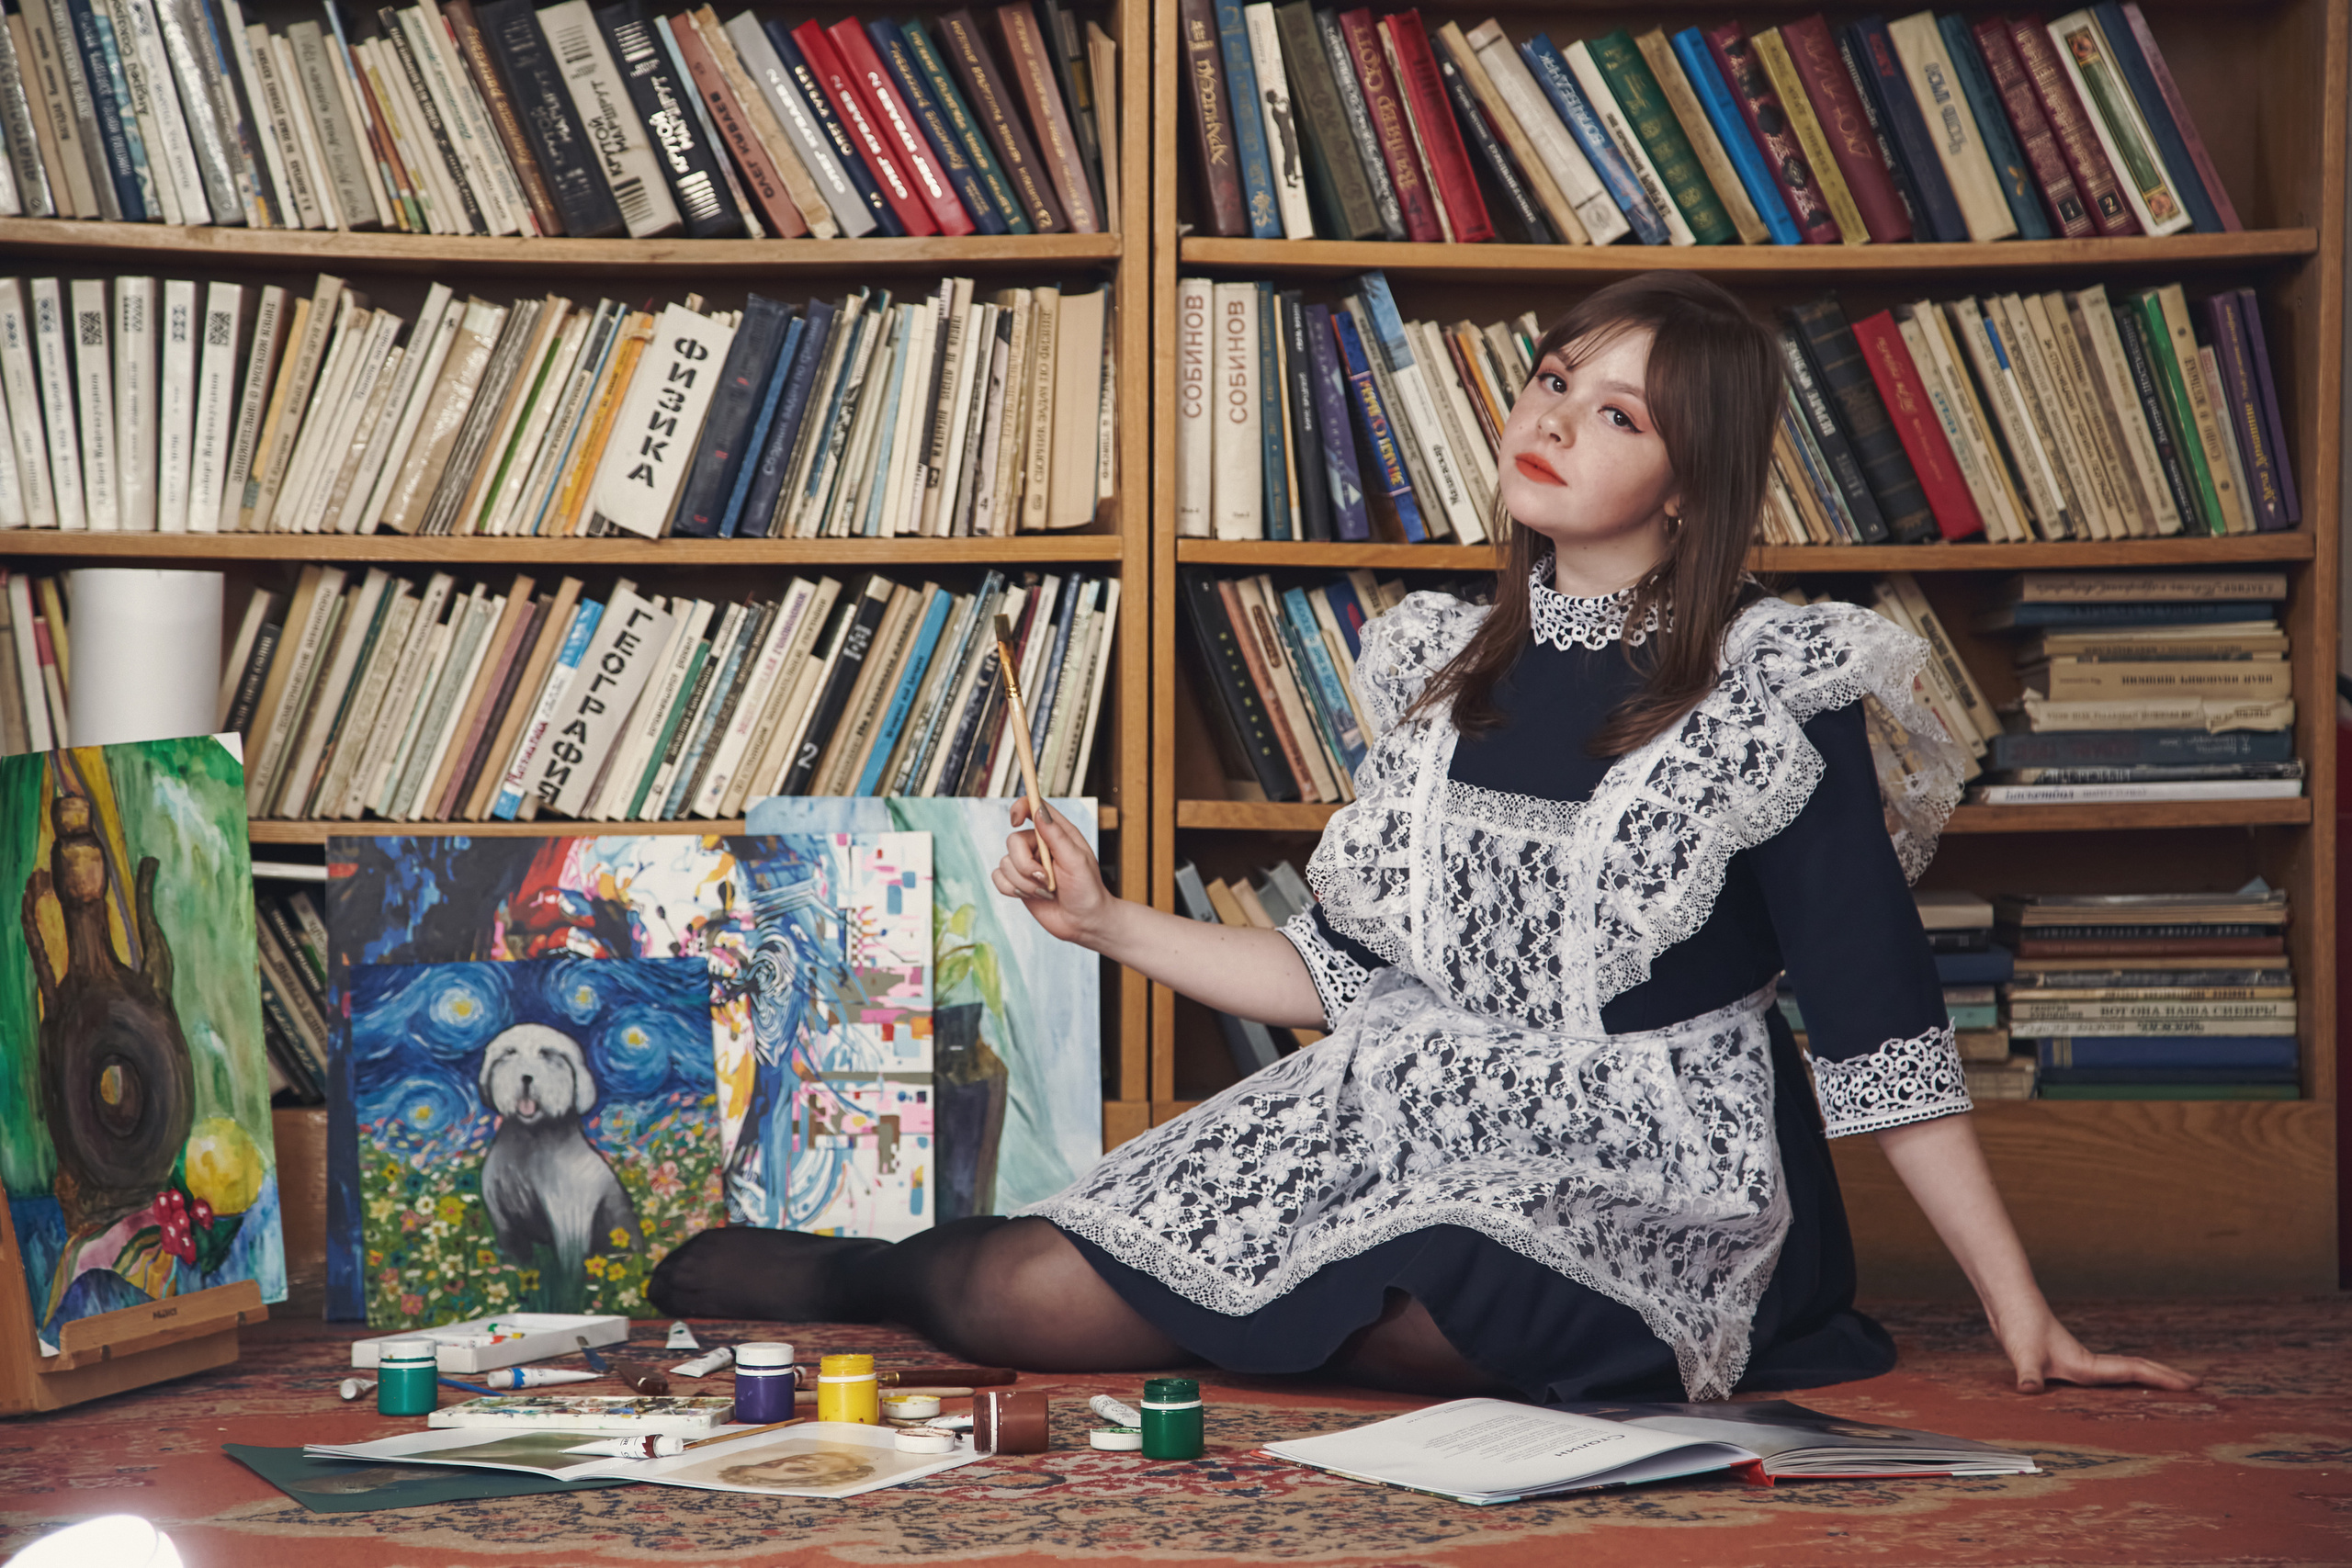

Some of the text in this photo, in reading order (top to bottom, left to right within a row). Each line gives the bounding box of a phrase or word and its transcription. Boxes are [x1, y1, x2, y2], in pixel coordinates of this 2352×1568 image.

[108, 0, 137, 57] Сахаро
[586, 115, 624, 177] КРУТОЙ
[589, 77, 629, 153] МАРШРУТ
[647, 109, 690, 175] КРУТОЙ
[650, 72, 695, 152] МАРШРУТ
[708, 89, 776, 199] ОЛЕГ КУВАЕВ
[775, 82, 820, 150] КУВАЕВ
[838, 88, 883, 155] КУВАЕВ
[875, 85, 918, 154] КУВАЕВ
[1192, 57, 1230, 167] ХРАНИТЕЛИ
[813, 147, 846, 195] ОЛЕГ
[876, 152, 910, 201] ОЛЕГ
[910, 151, 944, 200] ОЛЕГ
[1184, 294, 1203, 418] СОБИНОВ
[1227, 299, 1249, 423] СОБИНОВ
[627, 336, 709, 489] ФИЗИКА
[760, 314, 823, 478] Сборник задач по физике
[1032, 310, 1053, 483] СБОРНИК ЗАДАЧ ПО ФИЗИКЕ
[537, 608, 653, 806] ГЕОГРАФИЯ
[797, 742, 819, 770] 2
[1553, 1434, 1626, 1458] Сталин
